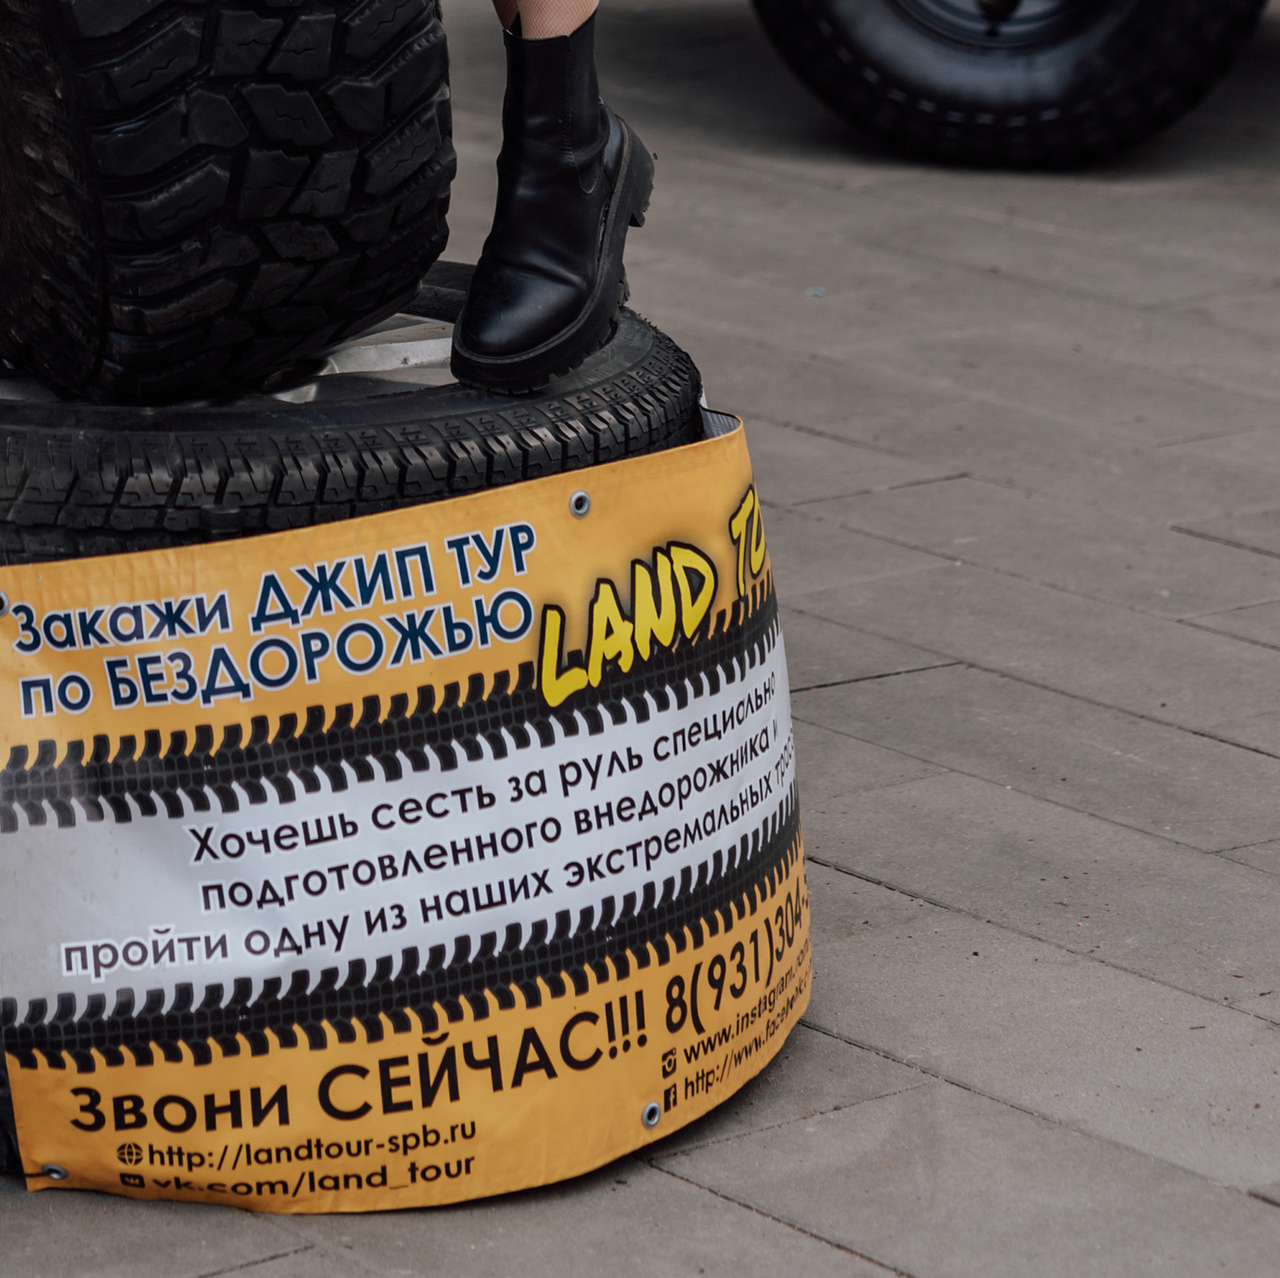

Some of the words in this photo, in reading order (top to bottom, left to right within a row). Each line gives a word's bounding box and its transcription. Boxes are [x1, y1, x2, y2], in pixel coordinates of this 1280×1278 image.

[10, 591, 233, 654] Закажи
[248, 542, 437, 636] ДЖИП
[443, 520, 537, 589] ТУР
[19, 671, 93, 719] по
[103, 587, 535, 710] БЕЗДОРОЖЬЮ
[538, 541, 718, 709] LAND
[189, 812, 359, 863] Хочешь
[371, 785, 496, 830] сесть
[508, 769, 548, 803] за
[558, 746, 643, 797] руль
[653, 670, 777, 762] специально
[201, 817, 562, 912] подготовленного
[575, 730, 770, 835] внедорожника
[64, 928, 228, 978] пройти
[244, 915, 350, 957] одну
[364, 904, 407, 936] из
[420, 868, 554, 923] наших
[565, 770, 773, 888] экстремальных
[70, 1085, 290, 1133] Звони
[318, 990, 648, 1120] СЕЙЧАС!!!
[148, 1121, 477, 1171] http://landtour-spb.ru
[151, 1155, 475, 1198] vk.com/land_tour
